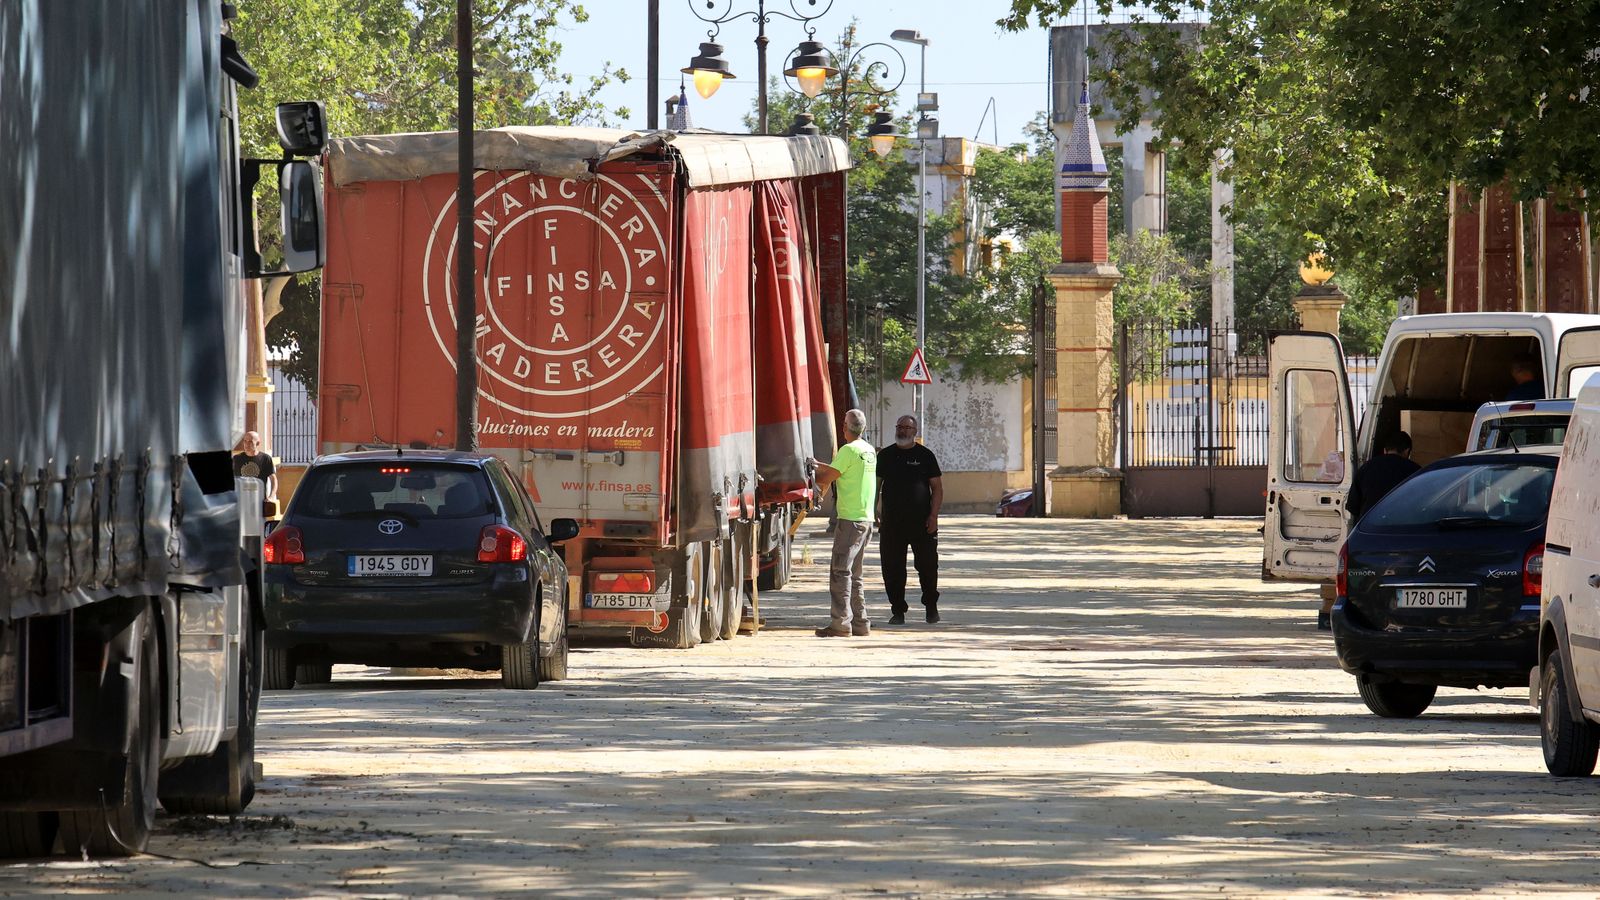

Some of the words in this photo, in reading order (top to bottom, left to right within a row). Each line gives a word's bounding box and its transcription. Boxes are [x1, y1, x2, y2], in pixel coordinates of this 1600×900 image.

[474, 178, 657, 268] NANCIERA
[497, 270, 617, 297] FINSA
[544, 219, 569, 343] FINSA
[475, 301, 656, 384] MADERERA
[476, 416, 550, 437] oluciones
[557, 423, 578, 437] en
[587, 420, 655, 438] madera
[561, 479, 653, 493] www.finsa.es
[359, 557, 395, 571] 1945
[401, 557, 430, 571] GDY
[593, 595, 625, 607] 7185
[629, 595, 653, 608] DTX
[1405, 591, 1435, 606] 1780
[1438, 591, 1463, 606] GHT
